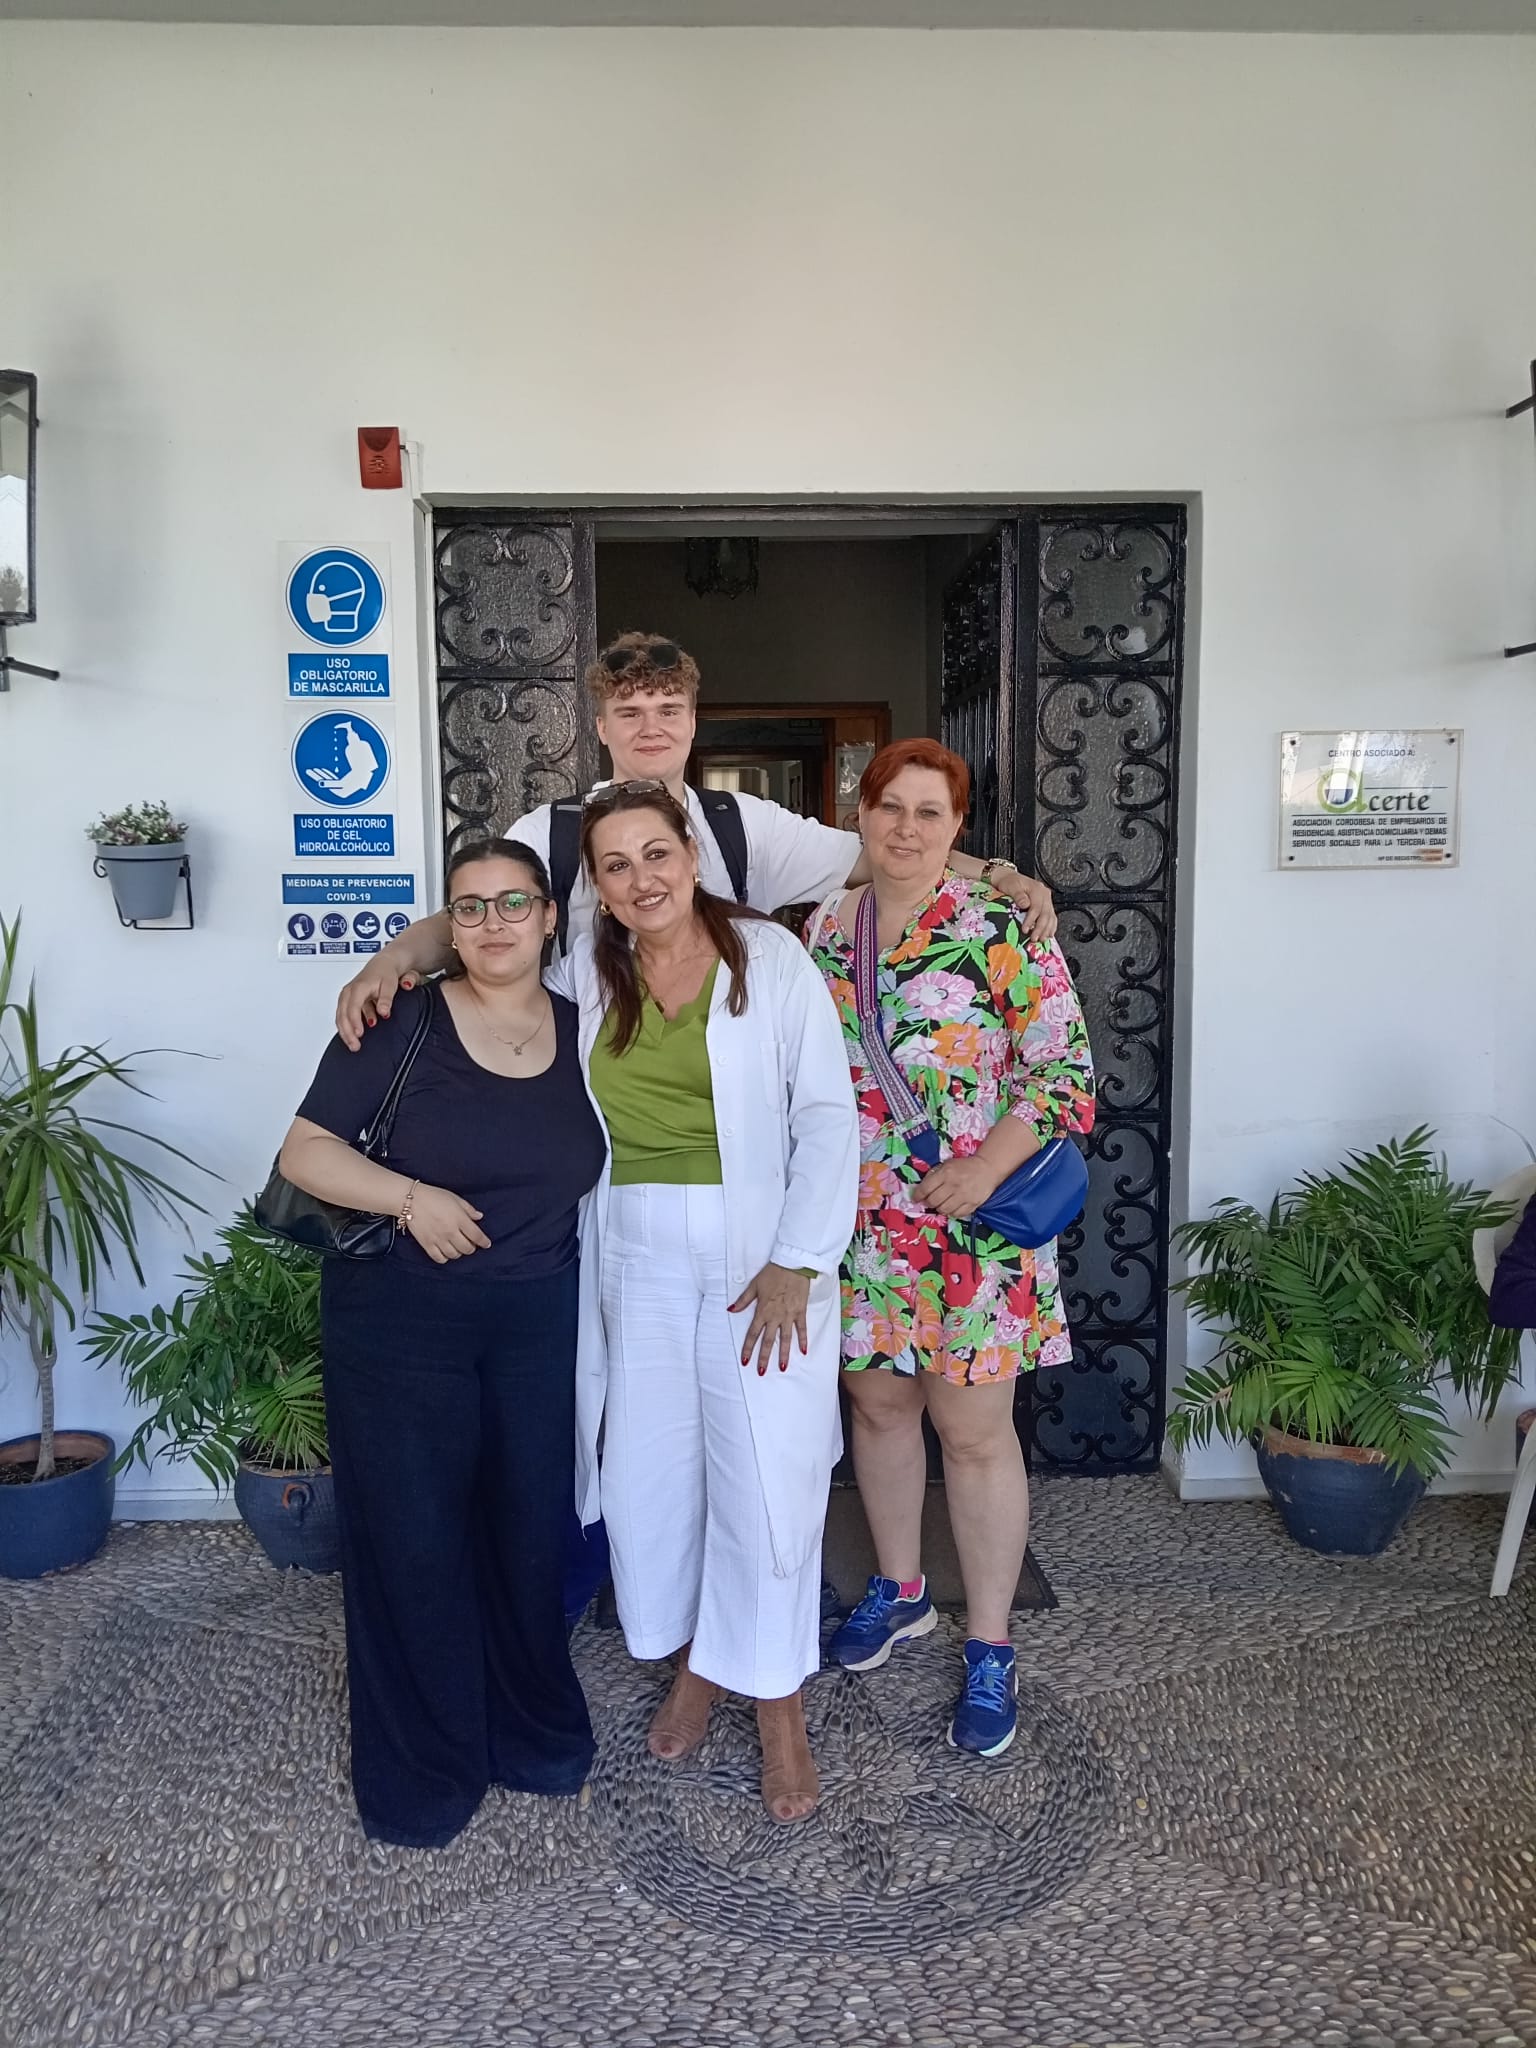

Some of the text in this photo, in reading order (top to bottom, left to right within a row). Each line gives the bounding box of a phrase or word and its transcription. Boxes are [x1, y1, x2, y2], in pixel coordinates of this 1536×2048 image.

[326, 658, 350, 669] USO
[300, 670, 377, 681] OBLIGATORIO
[293, 682, 385, 693] DE MASCARILLA
[1364, 749, 1406, 757] ASOCIADO
[300, 818, 387, 828] USO OBLIGATORIO
[1336, 818, 1375, 826] CORDOBESA
[1390, 817, 1435, 825] EMPRESARIOS
[327, 830, 361, 840] DE GEL
[1338, 828, 1374, 836] ASISTENCIA
[1376, 828, 1418, 836] DOMICILIARIA
[299, 840, 390, 852] HIDROALCOHÓLICO
[1329, 839, 1360, 847] SOCIALES
[1397, 838, 1426, 846] TERCERA
[286, 877, 411, 888] MEDIDAS DE PREVENCIÓN
[326, 892, 371, 901] COVID-19
